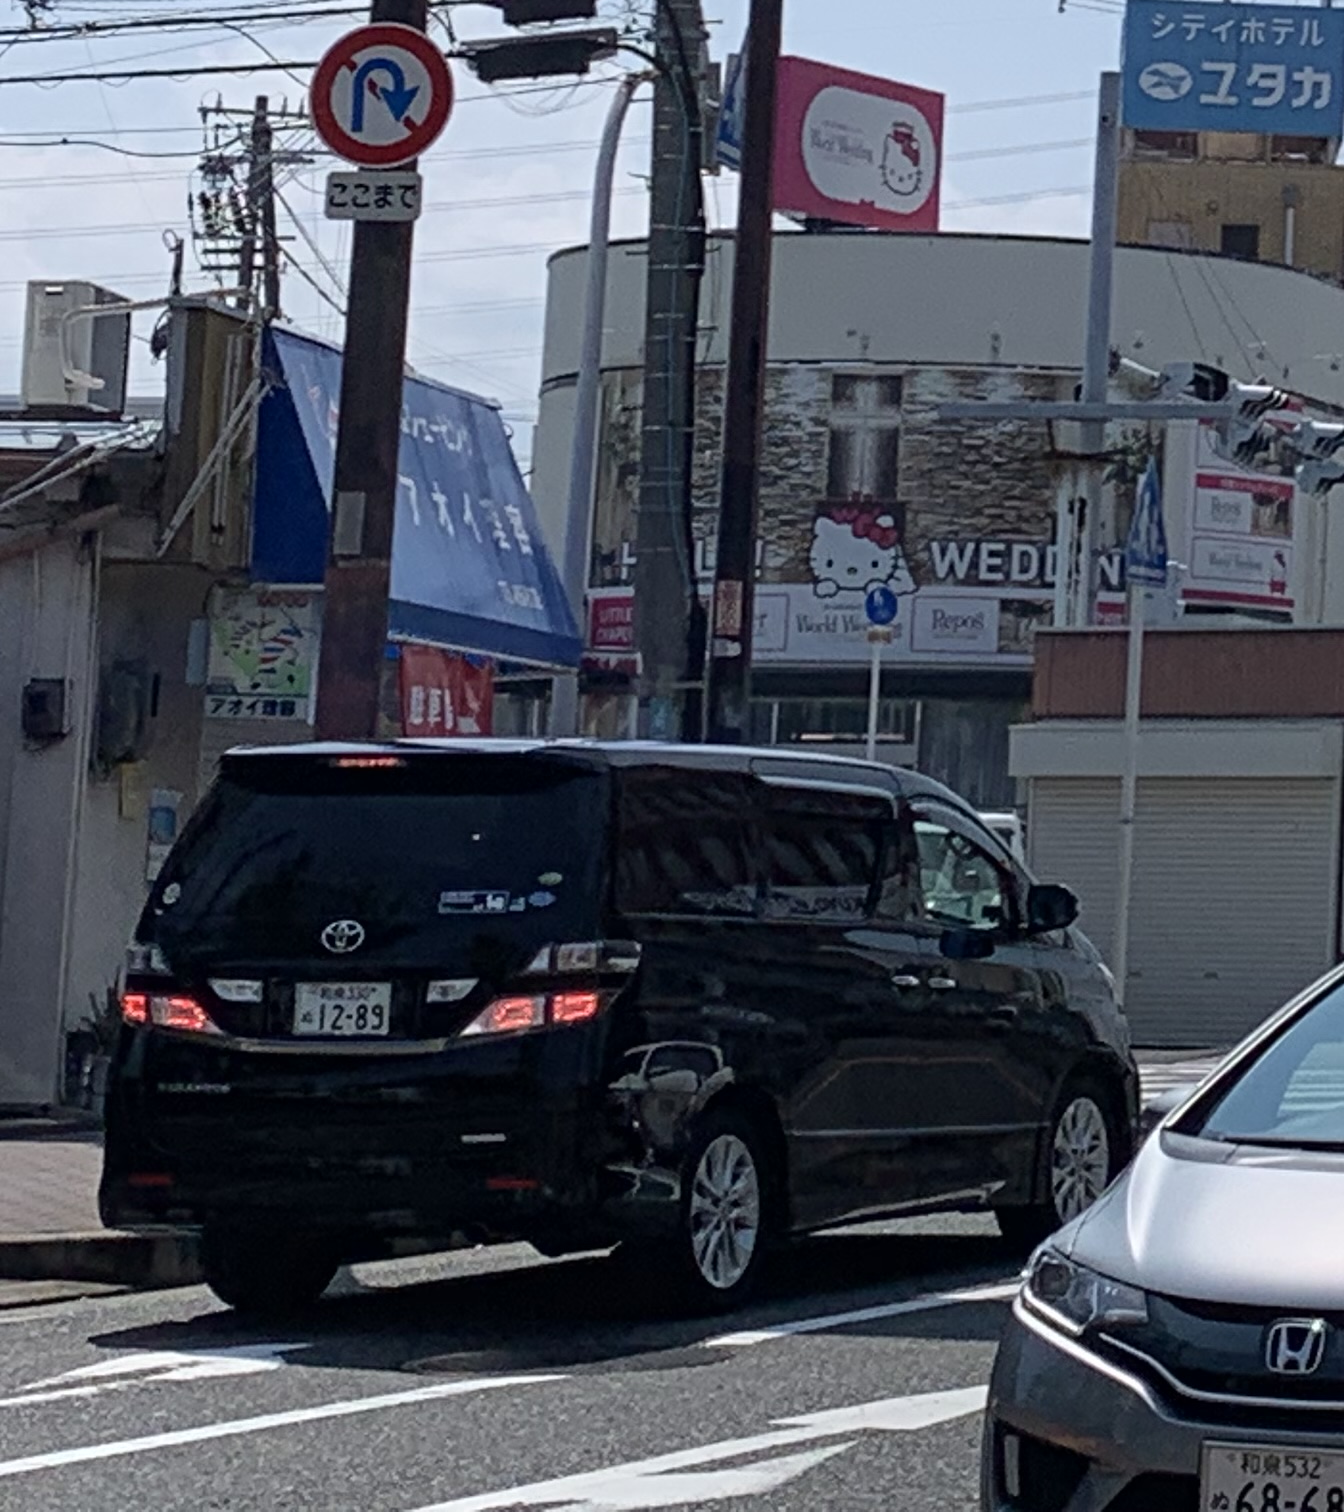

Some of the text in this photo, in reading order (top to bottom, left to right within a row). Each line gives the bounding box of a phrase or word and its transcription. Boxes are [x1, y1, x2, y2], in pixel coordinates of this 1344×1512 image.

[1199, 60, 1332, 110] ユタカ
[328, 182, 418, 209] ここまで
[318, 1003, 384, 1031] 12-89
